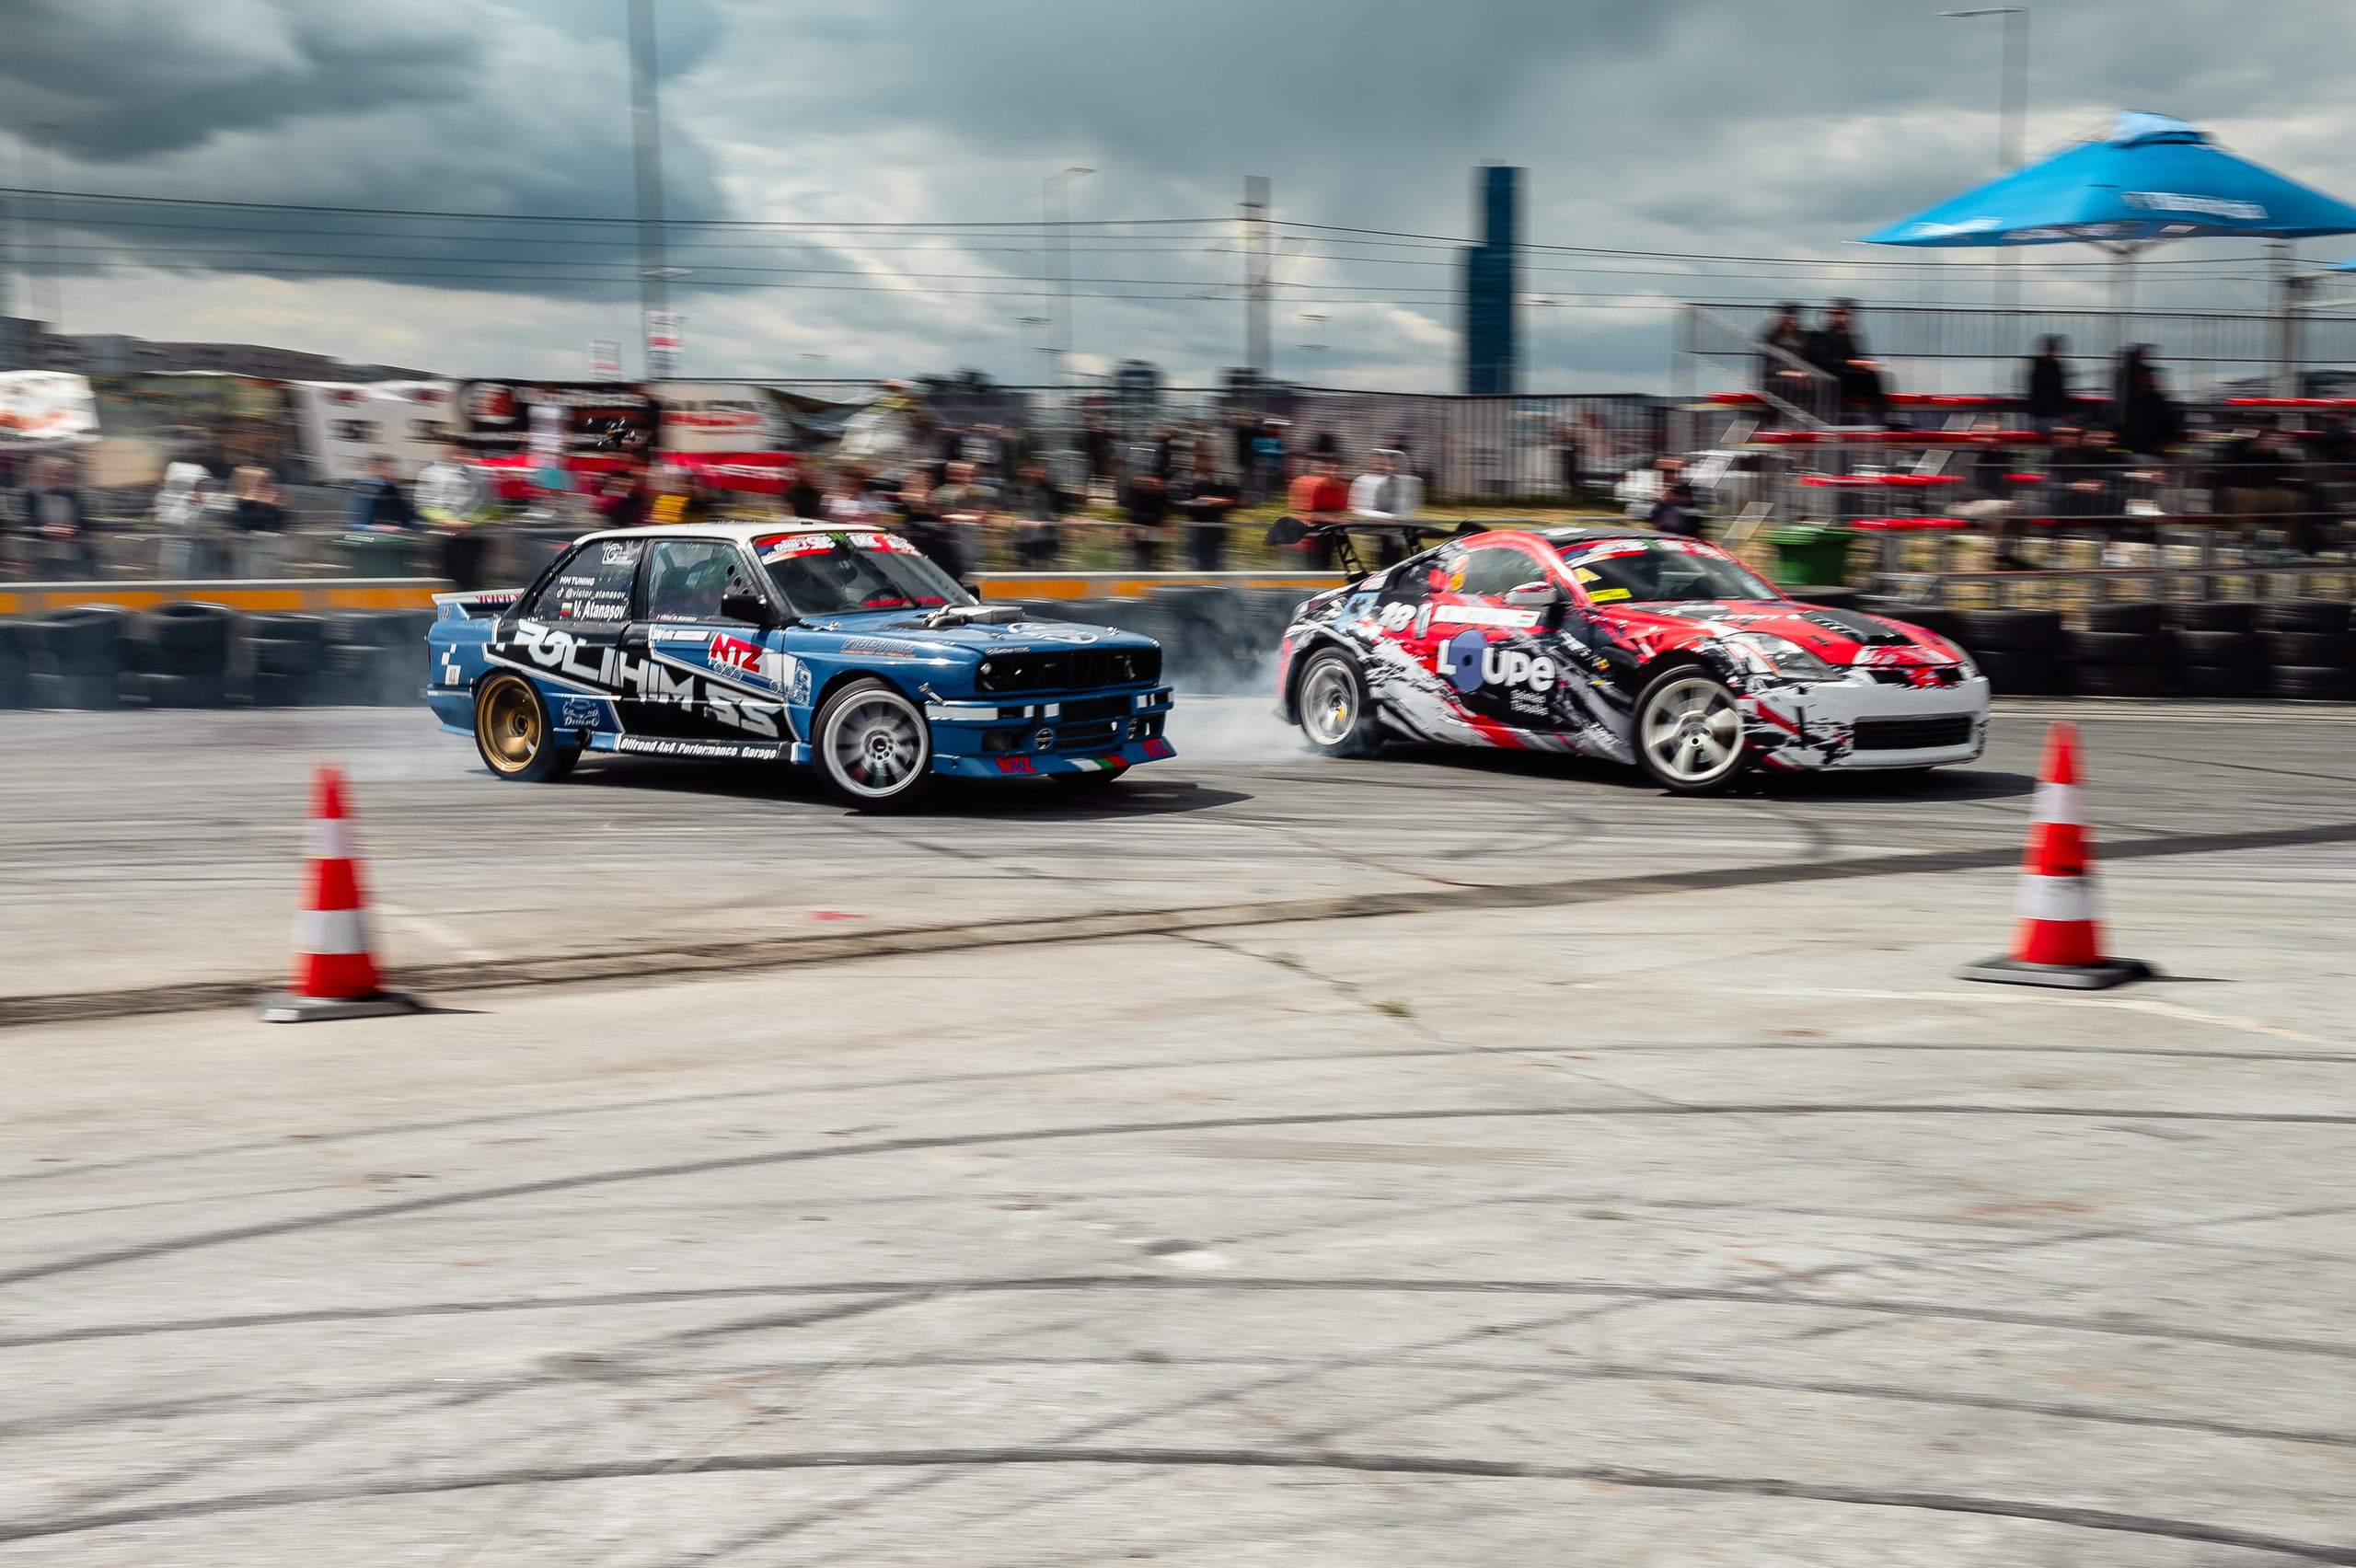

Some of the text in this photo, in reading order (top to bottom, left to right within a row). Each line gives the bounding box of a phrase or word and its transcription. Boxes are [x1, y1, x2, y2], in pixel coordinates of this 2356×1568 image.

[559, 575, 595, 586] MM TUNING
[572, 599, 583, 618] V.
[1378, 601, 1417, 632] 18
[710, 631, 765, 674] NTZ
[656, 741, 676, 754] 4x4
[676, 743, 738, 757] Performance
[741, 745, 778, 760] Garage
[995, 755, 1038, 774] NTZ
